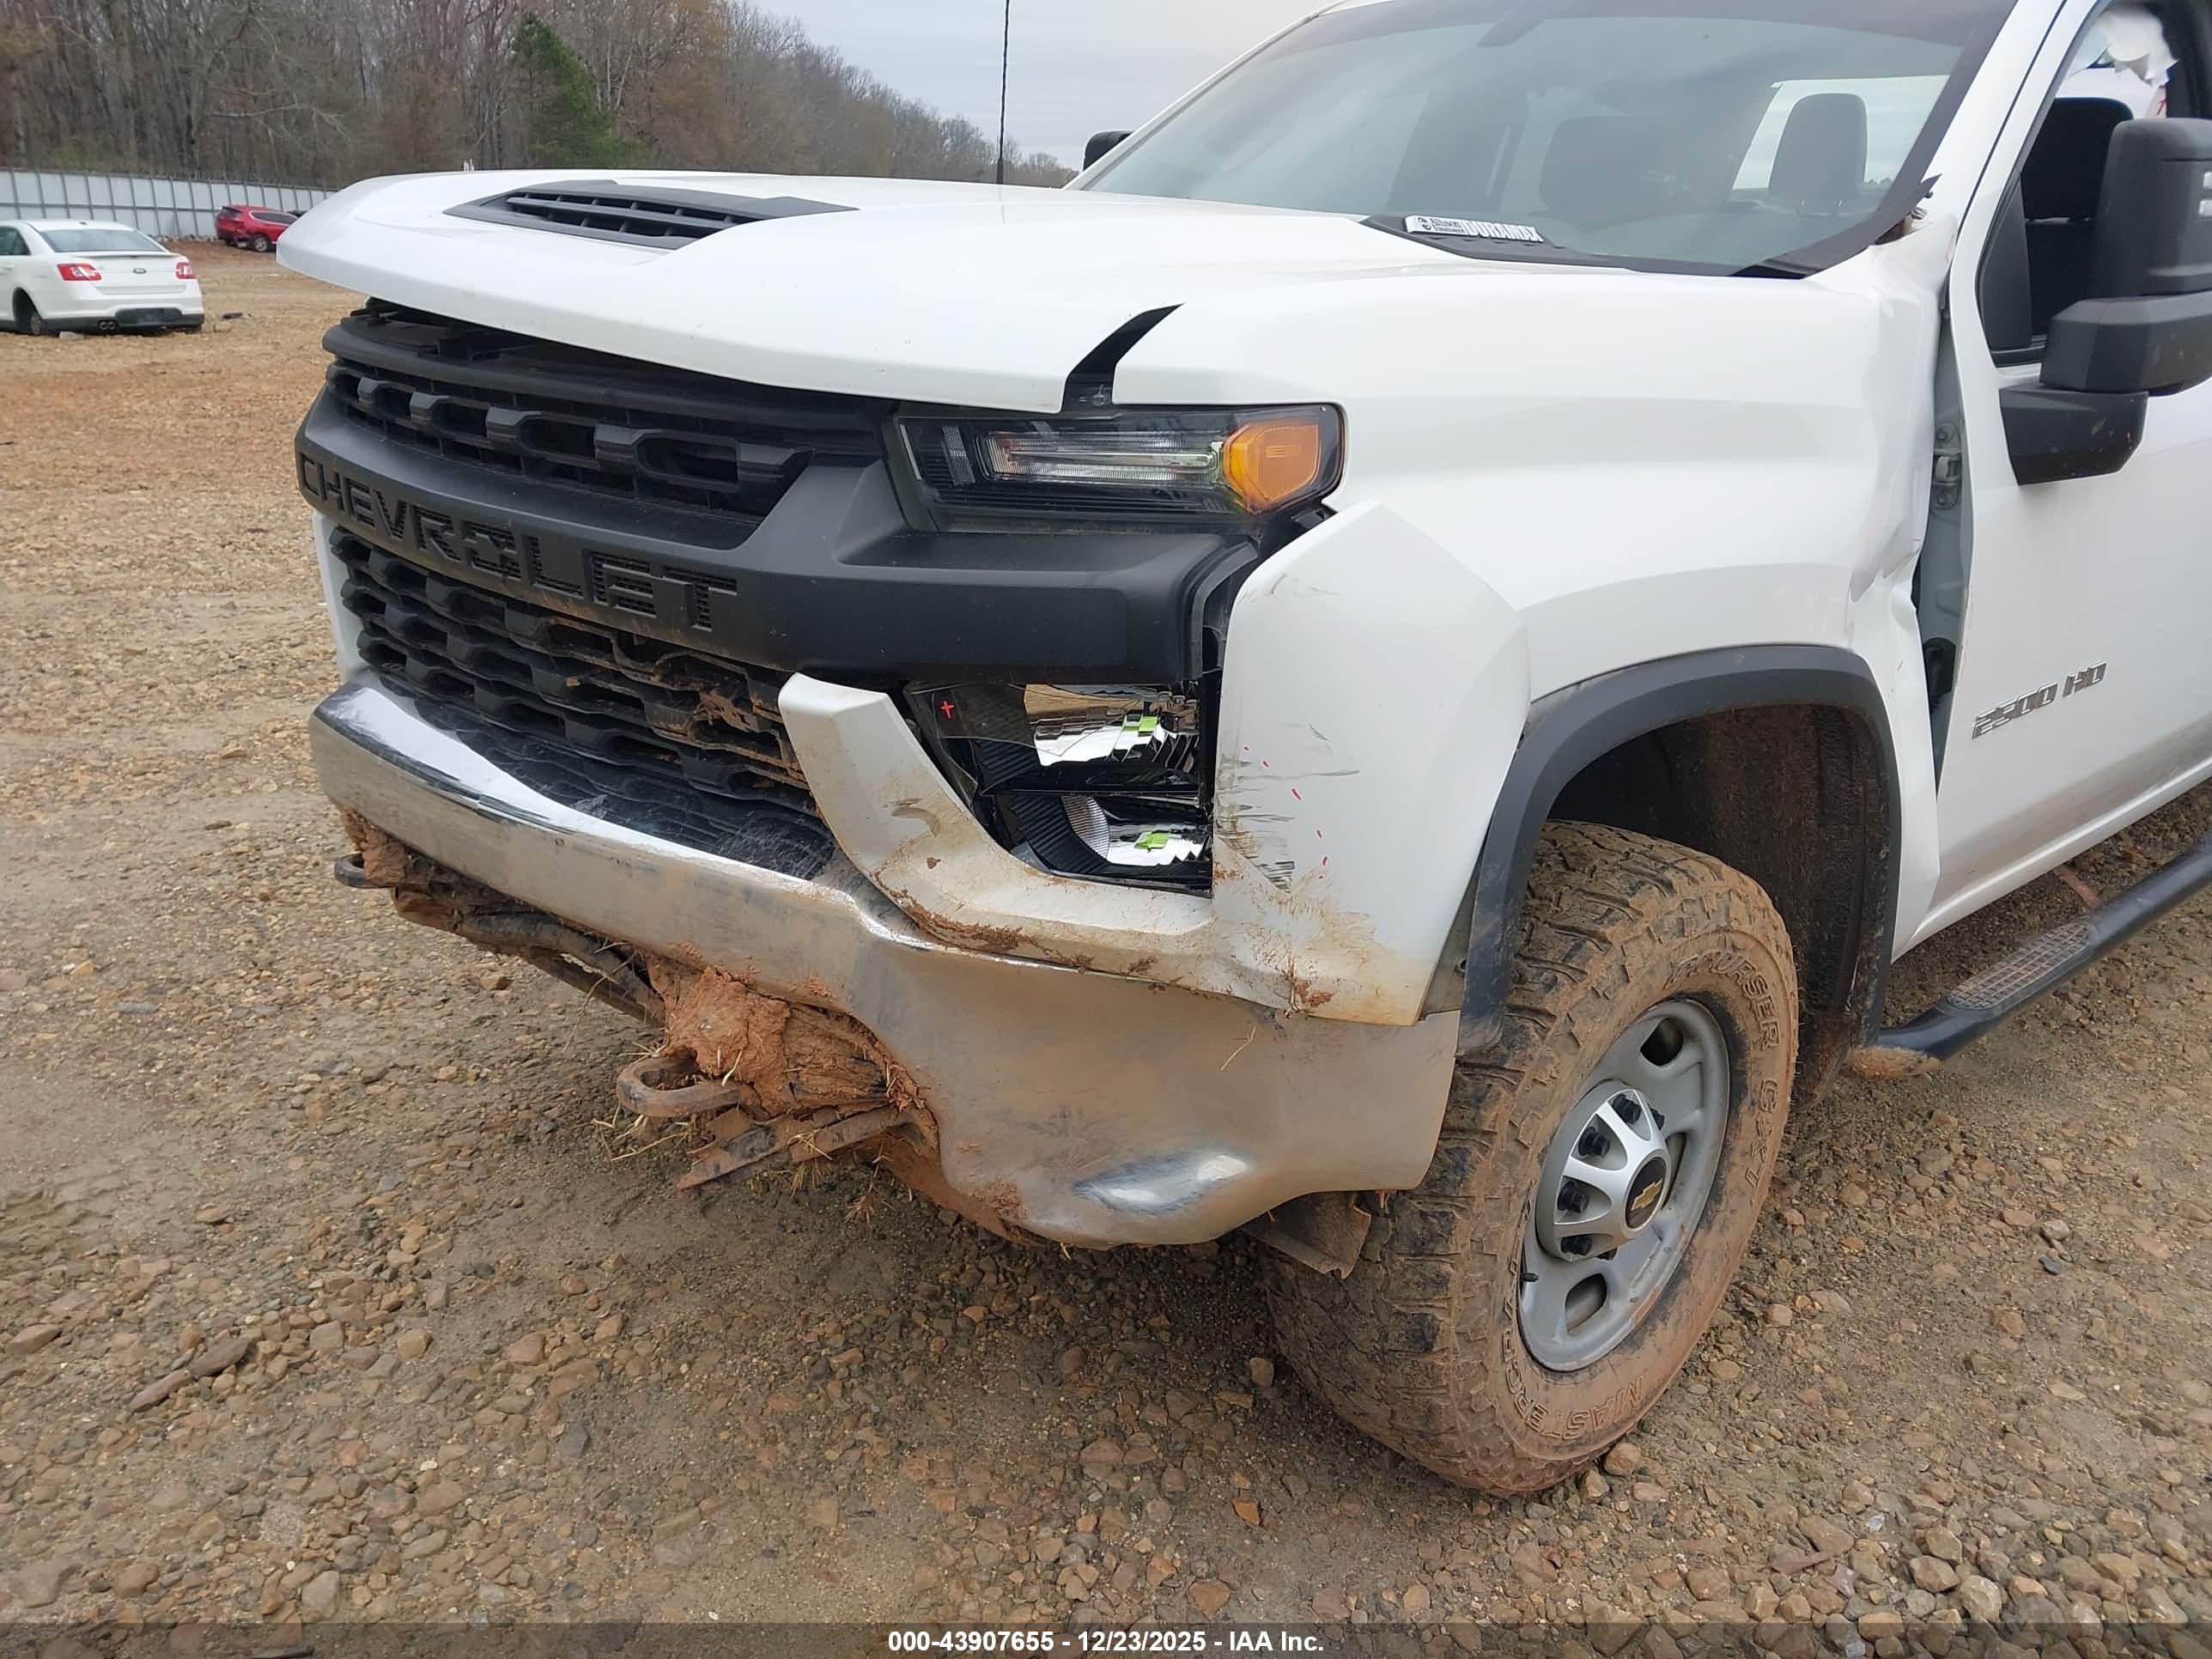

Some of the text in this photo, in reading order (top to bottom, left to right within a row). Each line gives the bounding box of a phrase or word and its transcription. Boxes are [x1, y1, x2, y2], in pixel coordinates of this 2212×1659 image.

[1430, 217, 1462, 228] Allison
[1465, 220, 1544, 243] DURAMAX
[300, 452, 738, 631] CHEVROLET
[1972, 660, 2107, 740] 2500 HD
